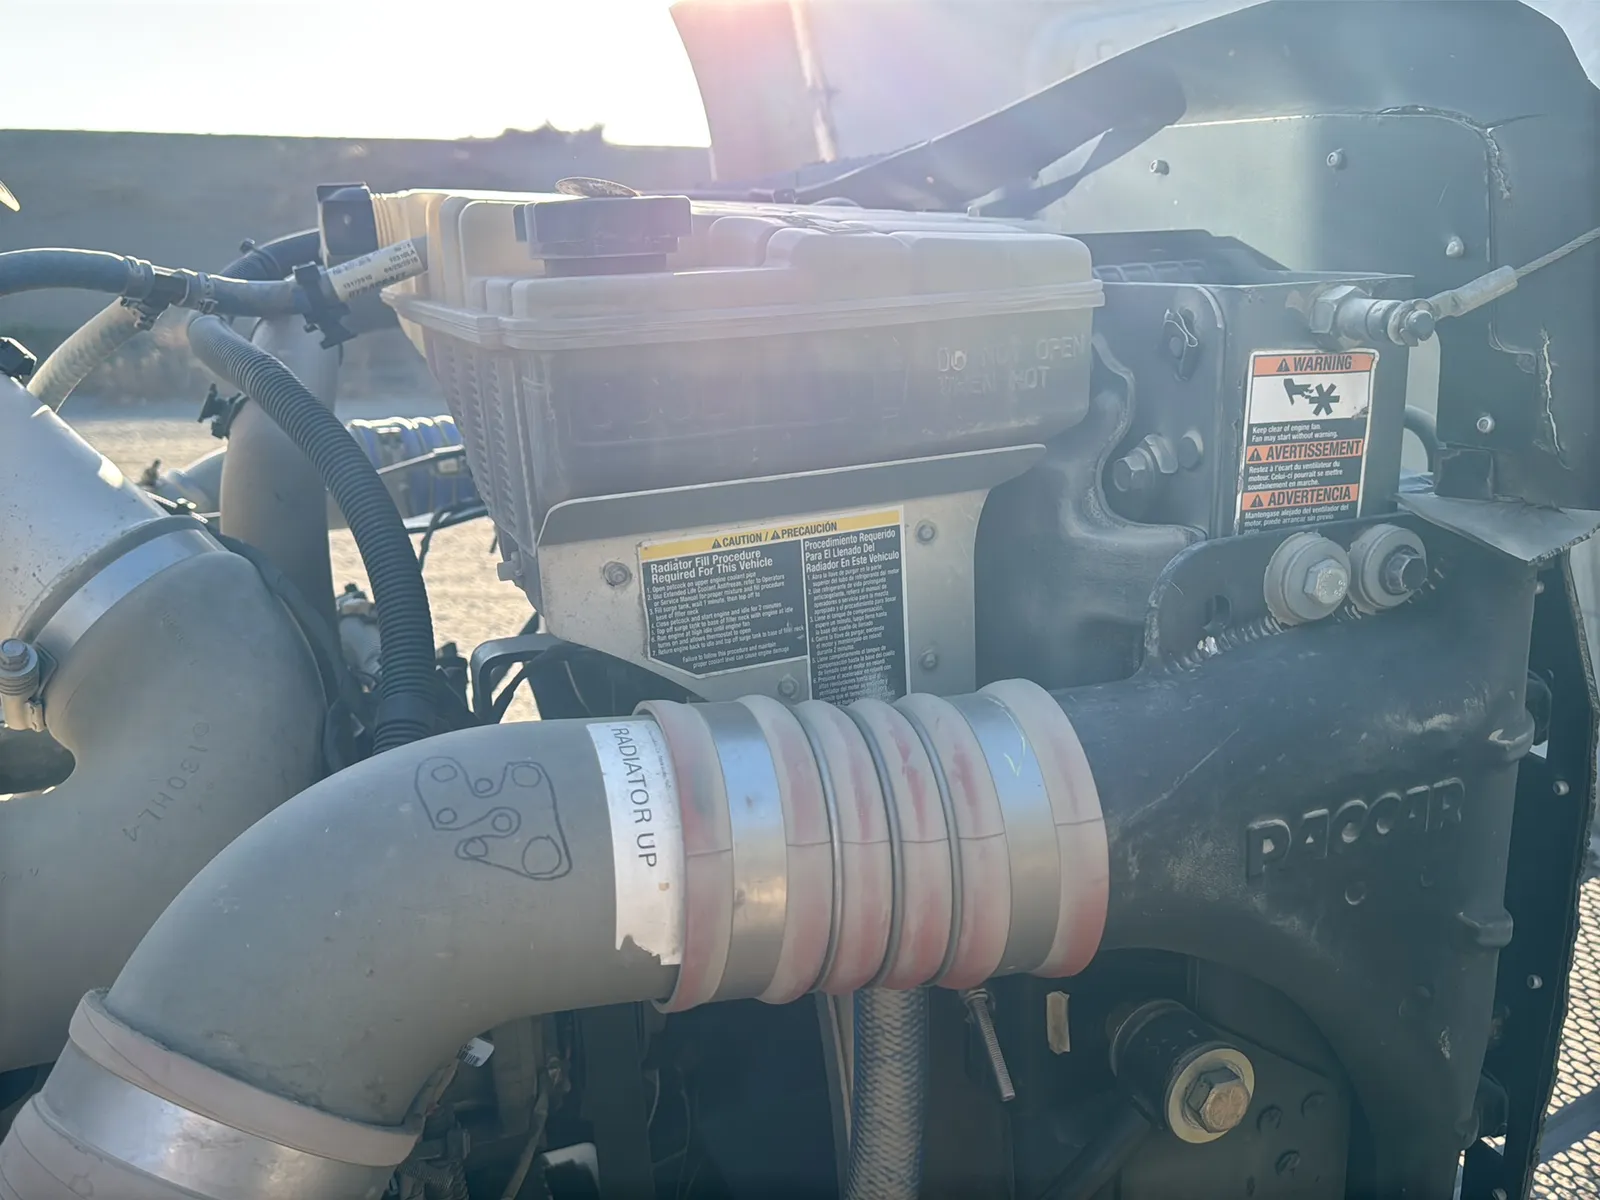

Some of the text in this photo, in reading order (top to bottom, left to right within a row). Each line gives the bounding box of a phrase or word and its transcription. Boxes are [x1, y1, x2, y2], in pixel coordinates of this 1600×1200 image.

[1036, 333, 1085, 361] OPEN
[1292, 355, 1352, 372] WARNING
[1009, 364, 1050, 391] HOT
[1253, 426, 1268, 434] Keep
[1291, 424, 1309, 432] engine
[1314, 430, 1339, 439] warning.
[1266, 440, 1361, 460] AVERTISSEMENT
[1268, 487, 1352, 506] ADVERTENCIA
[722, 532, 763, 548] CAUTION
[781, 521, 838, 539] PRECAUCIÓN
[805, 529, 895, 550] Procedimiento Requerido
[651, 549, 761, 573] Radiator Fill Procedure
[805, 542, 875, 561] Para El Llenado Del
[652, 557, 773, 586] Required For This Vehicle
[806, 559, 839, 573] Radiador
[841, 557, 850, 567] En
[852, 555, 867, 566] Este
[612, 726, 659, 868] RADIATOR UP
[1244, 777, 1466, 881] PACCAR
